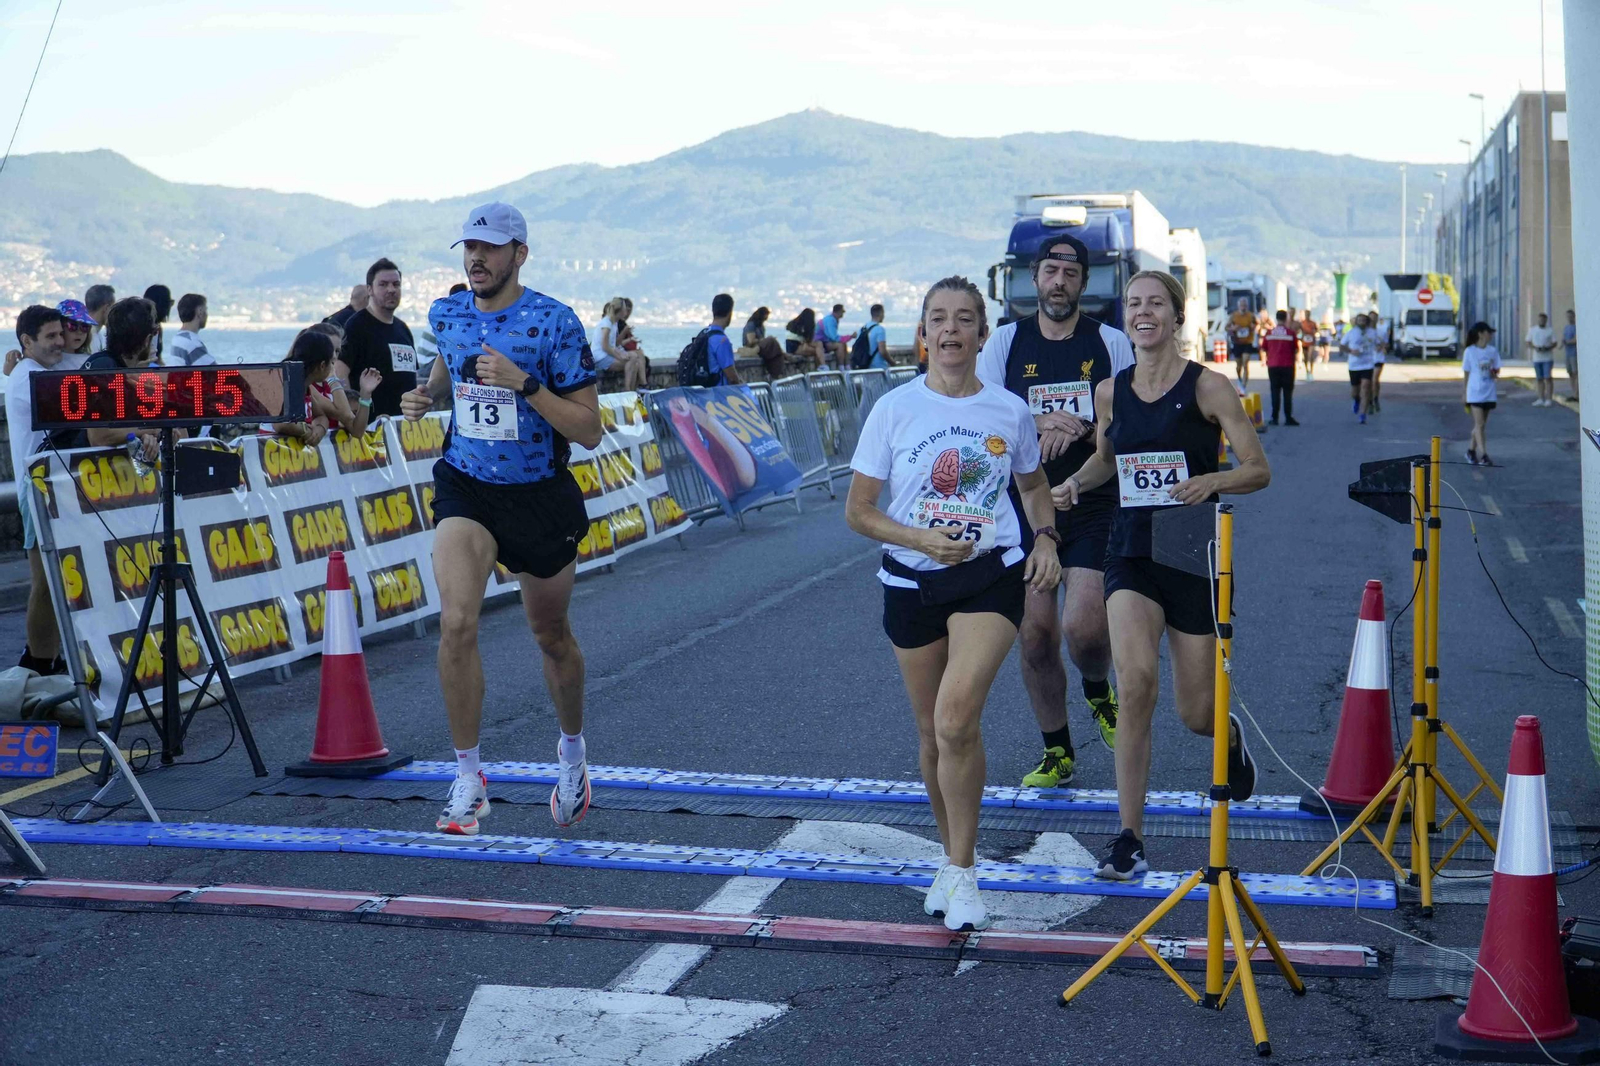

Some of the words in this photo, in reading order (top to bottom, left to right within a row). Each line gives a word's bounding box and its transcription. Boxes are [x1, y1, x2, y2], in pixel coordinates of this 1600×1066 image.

[397, 352, 414, 362] 548
[59, 369, 244, 421] 0:19:15
[471, 387, 495, 398] ALFONSO
[497, 390, 514, 399] MORO
[1030, 387, 1047, 396] 5KM
[1047, 385, 1063, 394] POR
[1064, 384, 1089, 393] MAURI
[469, 402, 501, 426] 13
[1041, 396, 1080, 415] 571
[401, 417, 445, 454] GADIS
[908, 440, 928, 464] 5Km
[928, 429, 947, 444] por
[950, 425, 984, 439] Mauri
[1119, 457, 1138, 465] 5KM
[1158, 454, 1184, 463] MAURI
[1134, 469, 1180, 489] 634
[919, 502, 939, 511] 5KM
[942, 504, 962, 513] POR
[964, 506, 993, 519] MAURI
[292, 506, 348, 553] GADIS
[375, 564, 422, 612] GADIS
[219, 603, 288, 656] GADIS
[120, 624, 200, 682] GAIS
